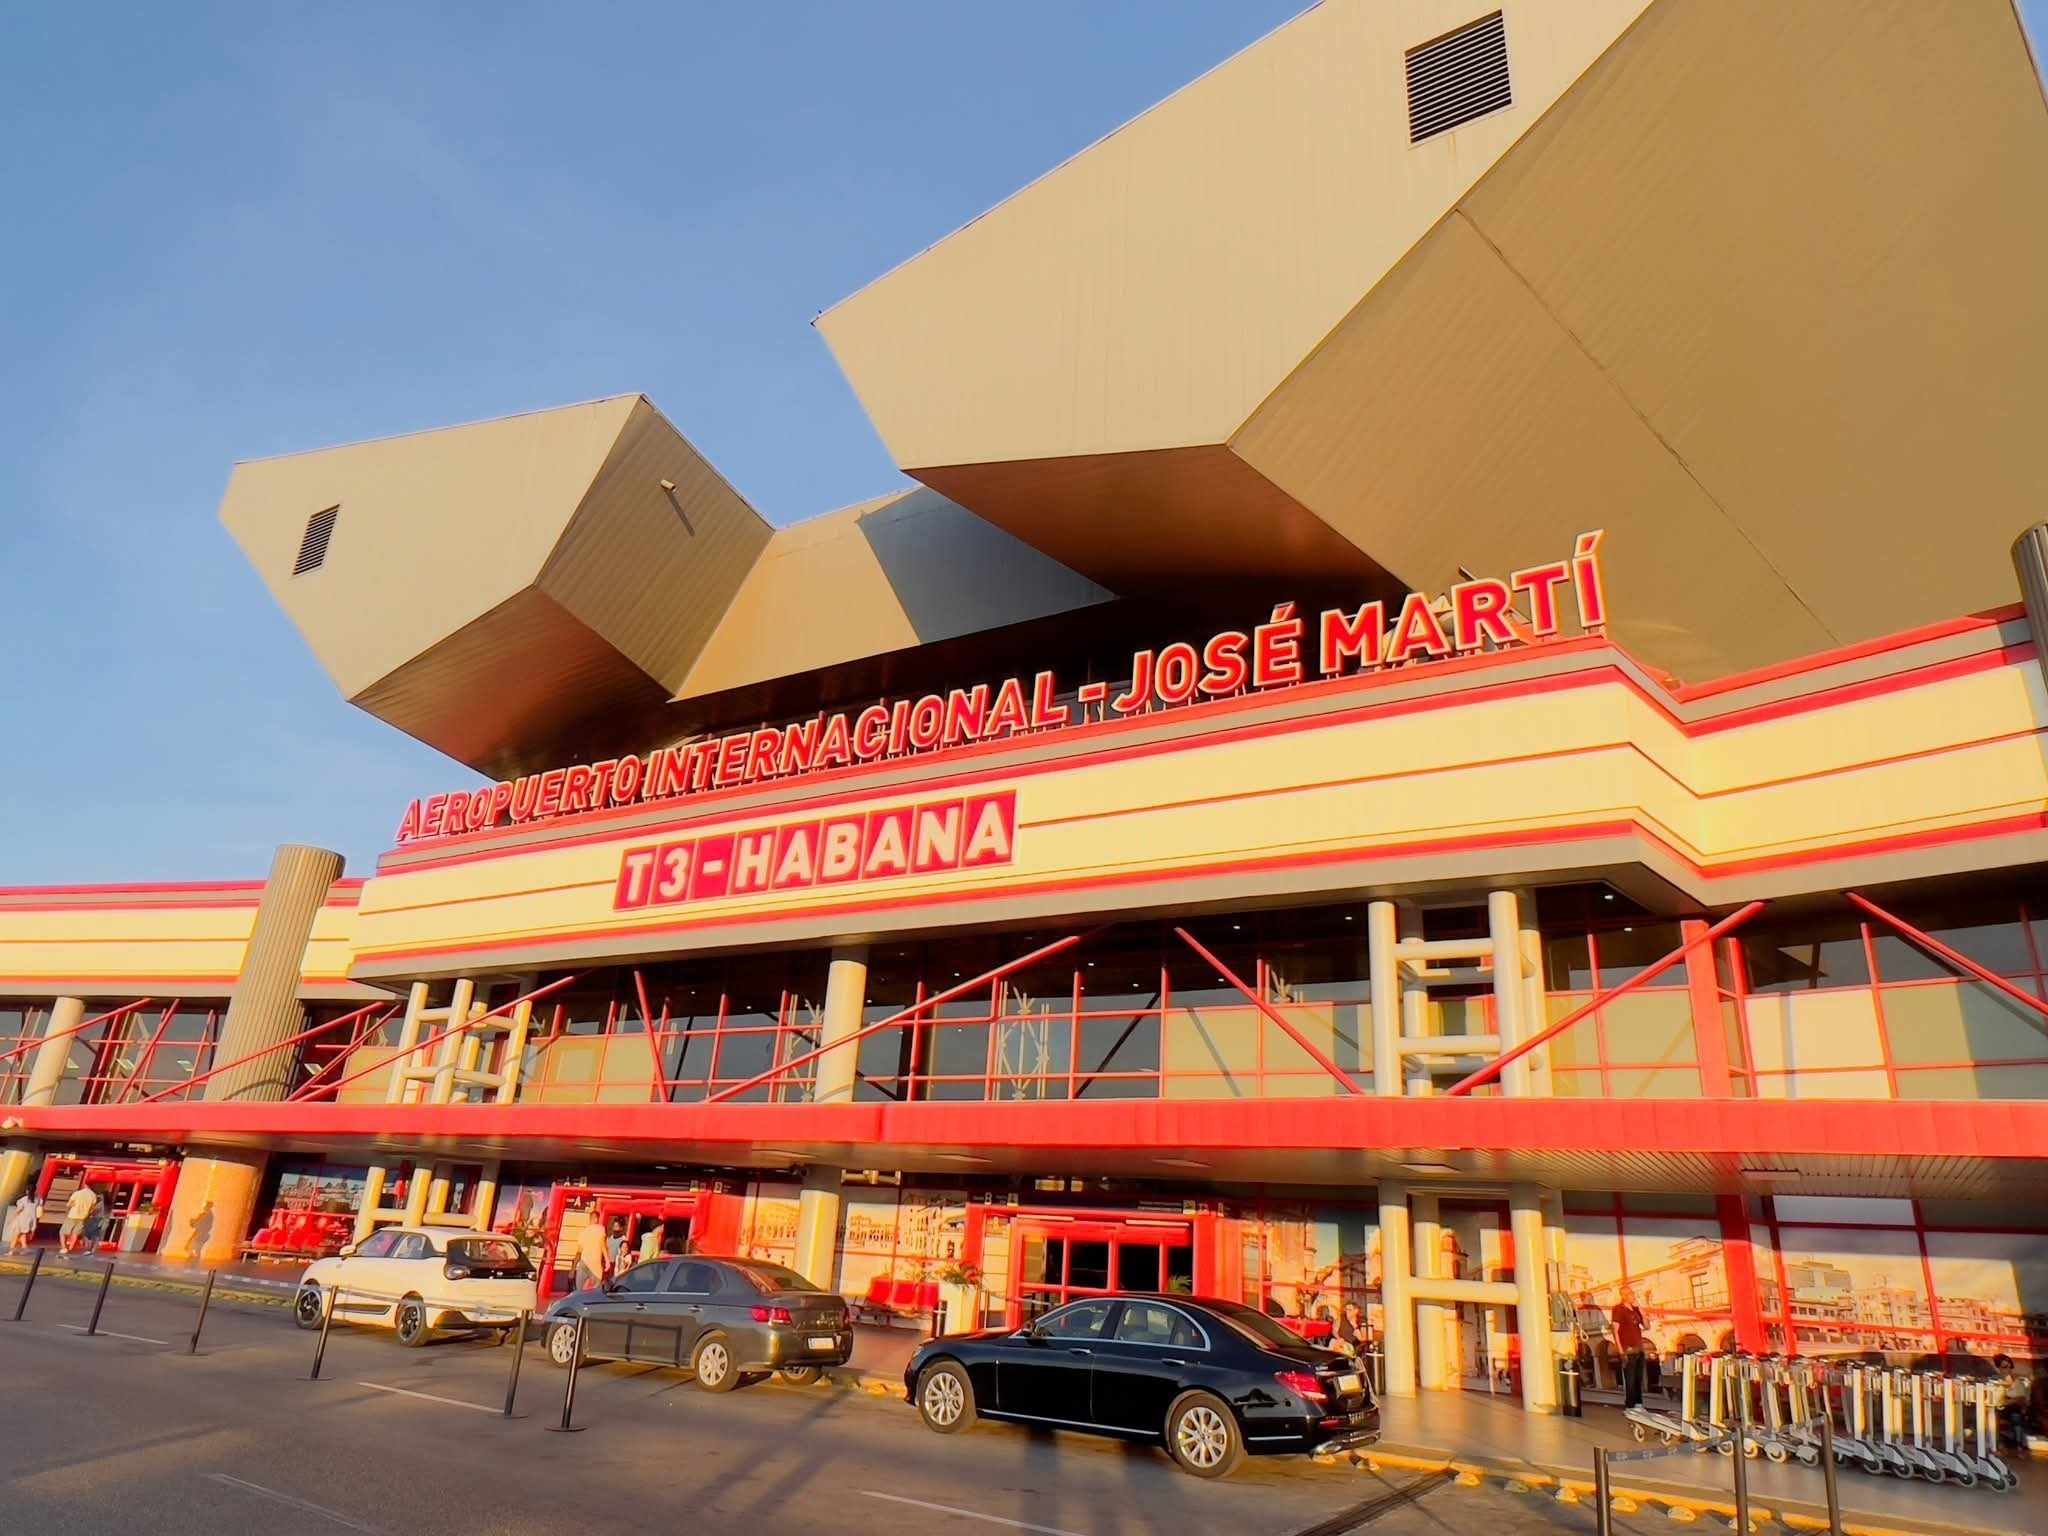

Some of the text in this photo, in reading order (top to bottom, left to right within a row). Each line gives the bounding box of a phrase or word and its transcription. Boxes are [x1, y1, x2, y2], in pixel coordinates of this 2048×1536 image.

[396, 754, 641, 841] AEROPUERTO
[644, 670, 1067, 797] INTERNACIONAL
[1113, 602, 1302, 712] JOSÉ
[1320, 529, 1605, 674] MARTÍ
